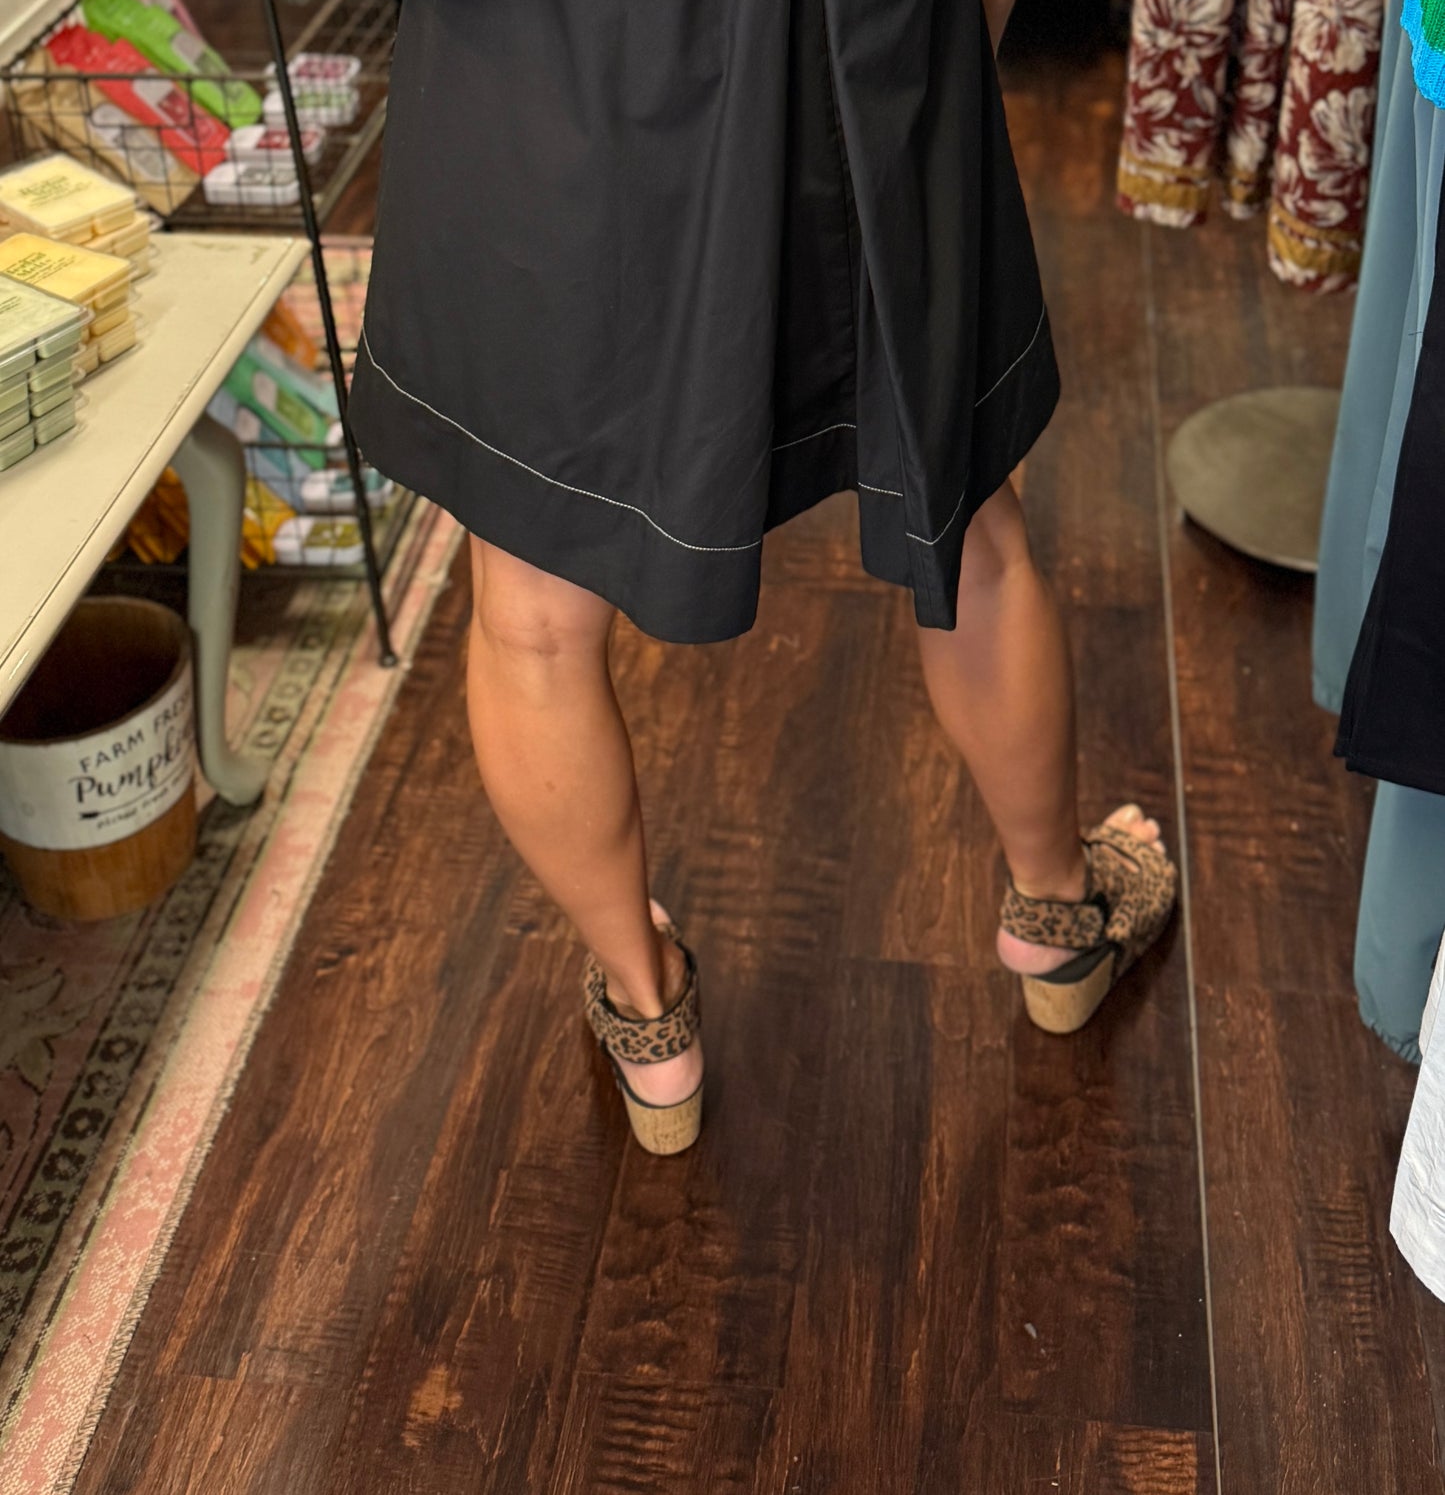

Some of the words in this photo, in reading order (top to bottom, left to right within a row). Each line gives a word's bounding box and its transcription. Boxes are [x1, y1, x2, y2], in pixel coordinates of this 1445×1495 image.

[68, 724, 193, 804] Pumpki
[79, 728, 145, 774] FARM
[153, 687, 191, 734] FRE
